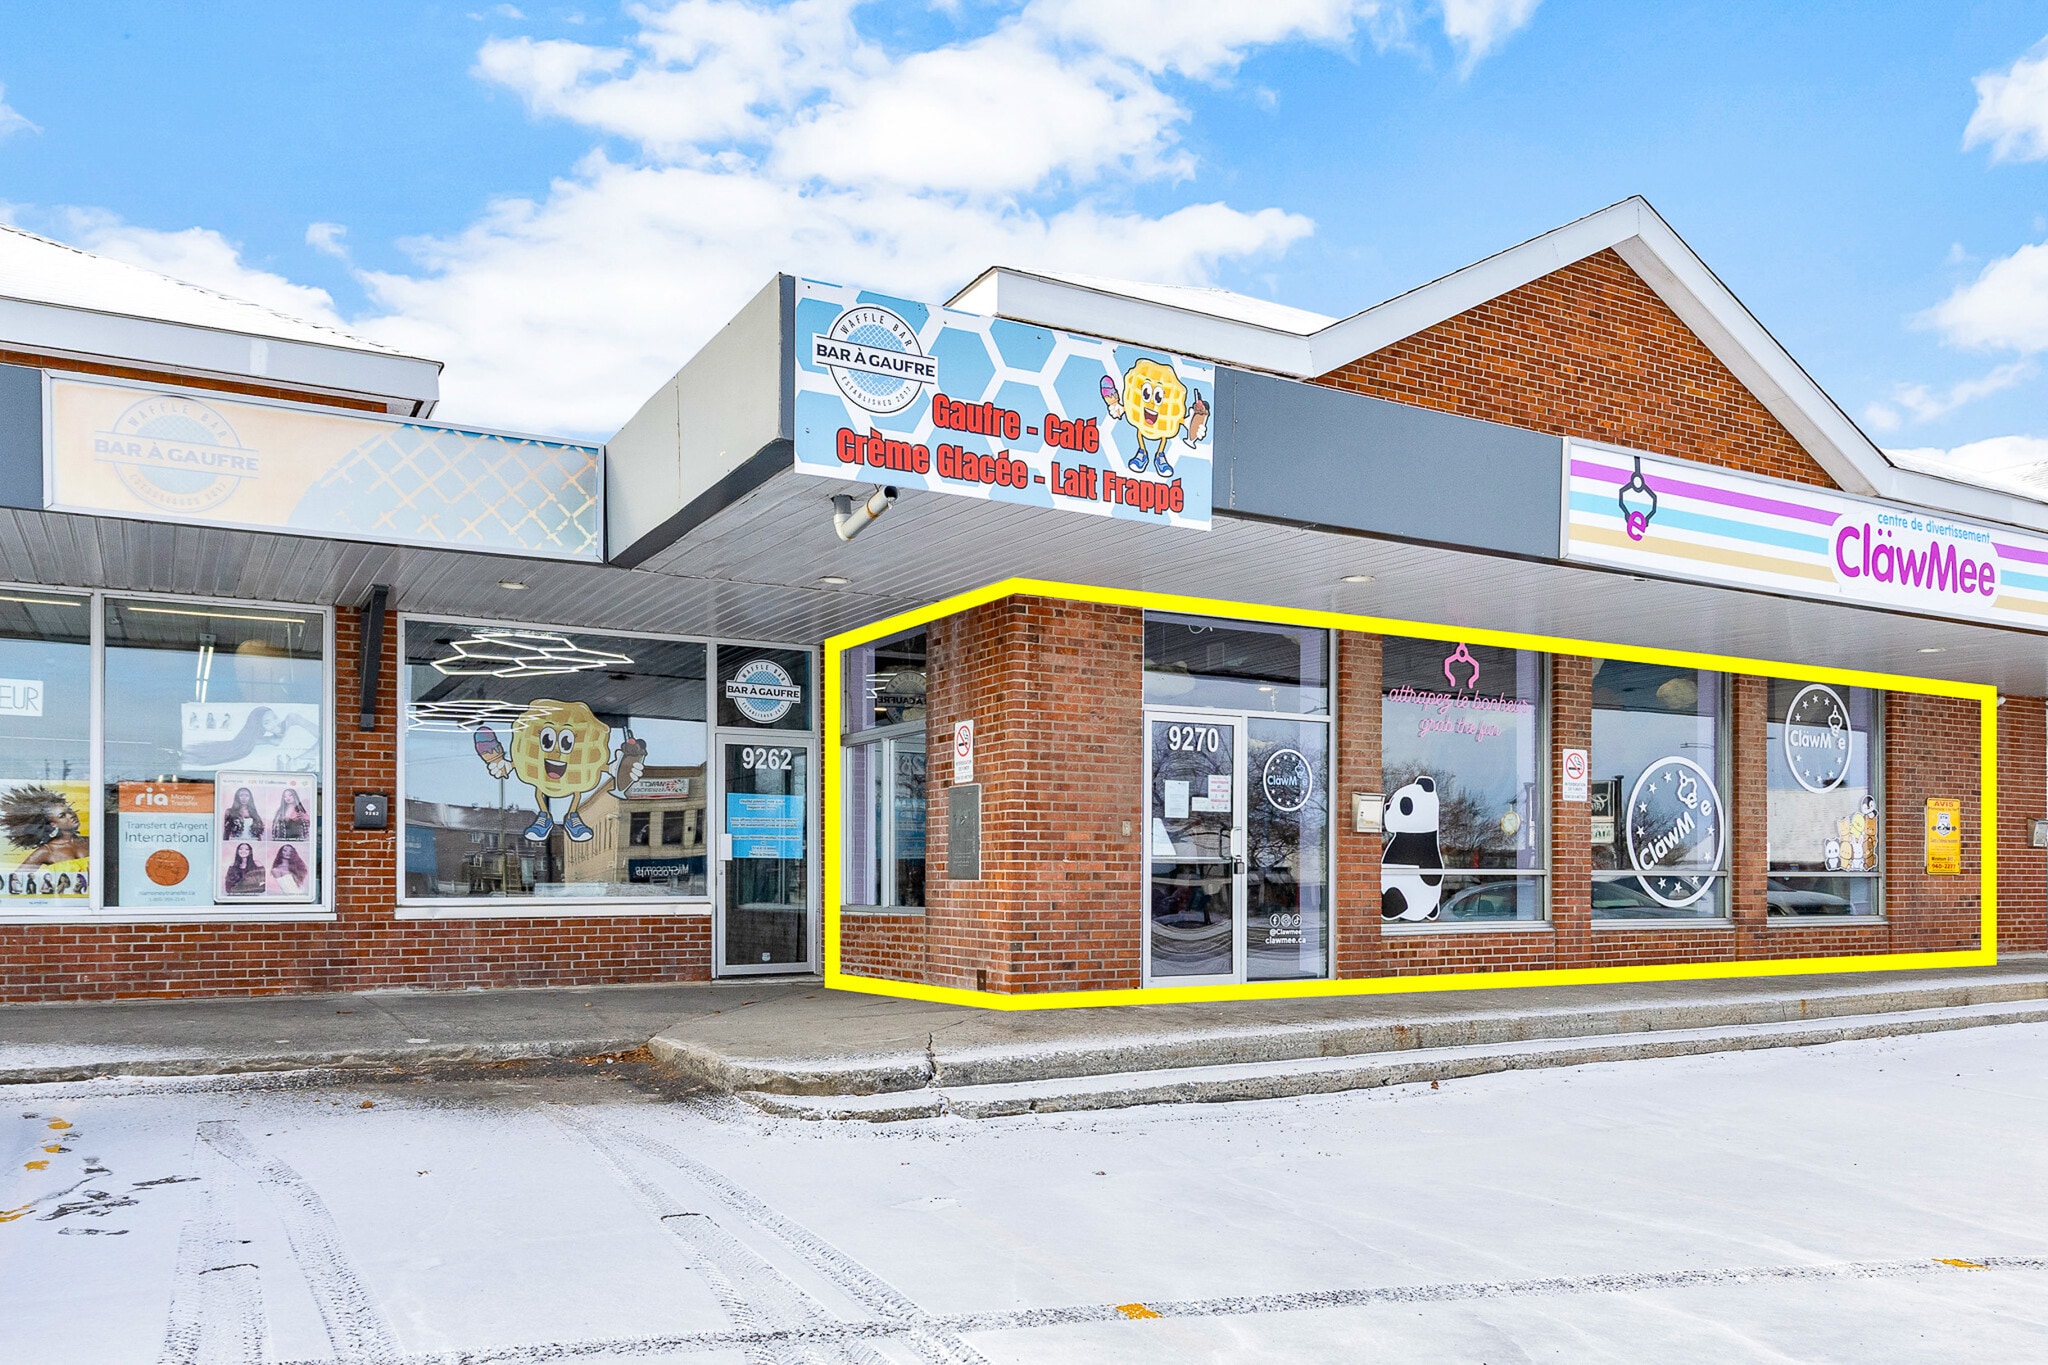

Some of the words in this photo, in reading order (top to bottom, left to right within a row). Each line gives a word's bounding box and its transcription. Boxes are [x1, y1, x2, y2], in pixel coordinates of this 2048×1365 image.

[840, 312, 885, 335] WAFFLE
[892, 323, 913, 347] BAR
[816, 343, 851, 362] BAR
[854, 347, 867, 365] À
[869, 354, 935, 378] GAUFRE
[841, 376, 892, 407] ESTABLISHED
[895, 386, 912, 403] 2017
[127, 402, 190, 428] WAFFLE
[200, 412, 229, 439] BAR
[932, 392, 1021, 441] Gaufre
[1044, 413, 1101, 454] Café
[94, 438, 142, 458] BAR
[146, 441, 165, 460] À
[167, 448, 260, 472] GAUFRE
[836, 427, 930, 475] Crème
[936, 443, 1028, 490] Glacée
[1051, 461, 1098, 501] Lait
[1102, 470, 1184, 515] Frappé
[1877, 512, 1908, 529] centre
[1910, 519, 1923, 532] de
[1925, 520, 1990, 544] divertissement
[1835, 522, 1996, 597] CläwMee
[741, 664, 769, 679] WAFFLE
[773, 668, 786, 682] BAR
[727, 685, 748, 695] BAR
[749, 684, 758, 695] À
[758, 687, 800, 699] GAUFRE
[1388, 684, 1452, 715] attrapez
[1455, 688, 1470, 709] le
[1168, 725, 1219, 753] 9270
[1418, 715, 1455, 738] grab
[1456, 717, 1477, 735] the
[1475, 721, 1502, 742] fun
[742, 747, 792, 770] 9262
[135, 787, 169, 806] ria
[125, 832, 209, 843] International
[126, 821, 167, 830] Transfert
[169, 822, 209, 831] d'Argent
[1264, 936, 1307, 945] clawmee.ca
